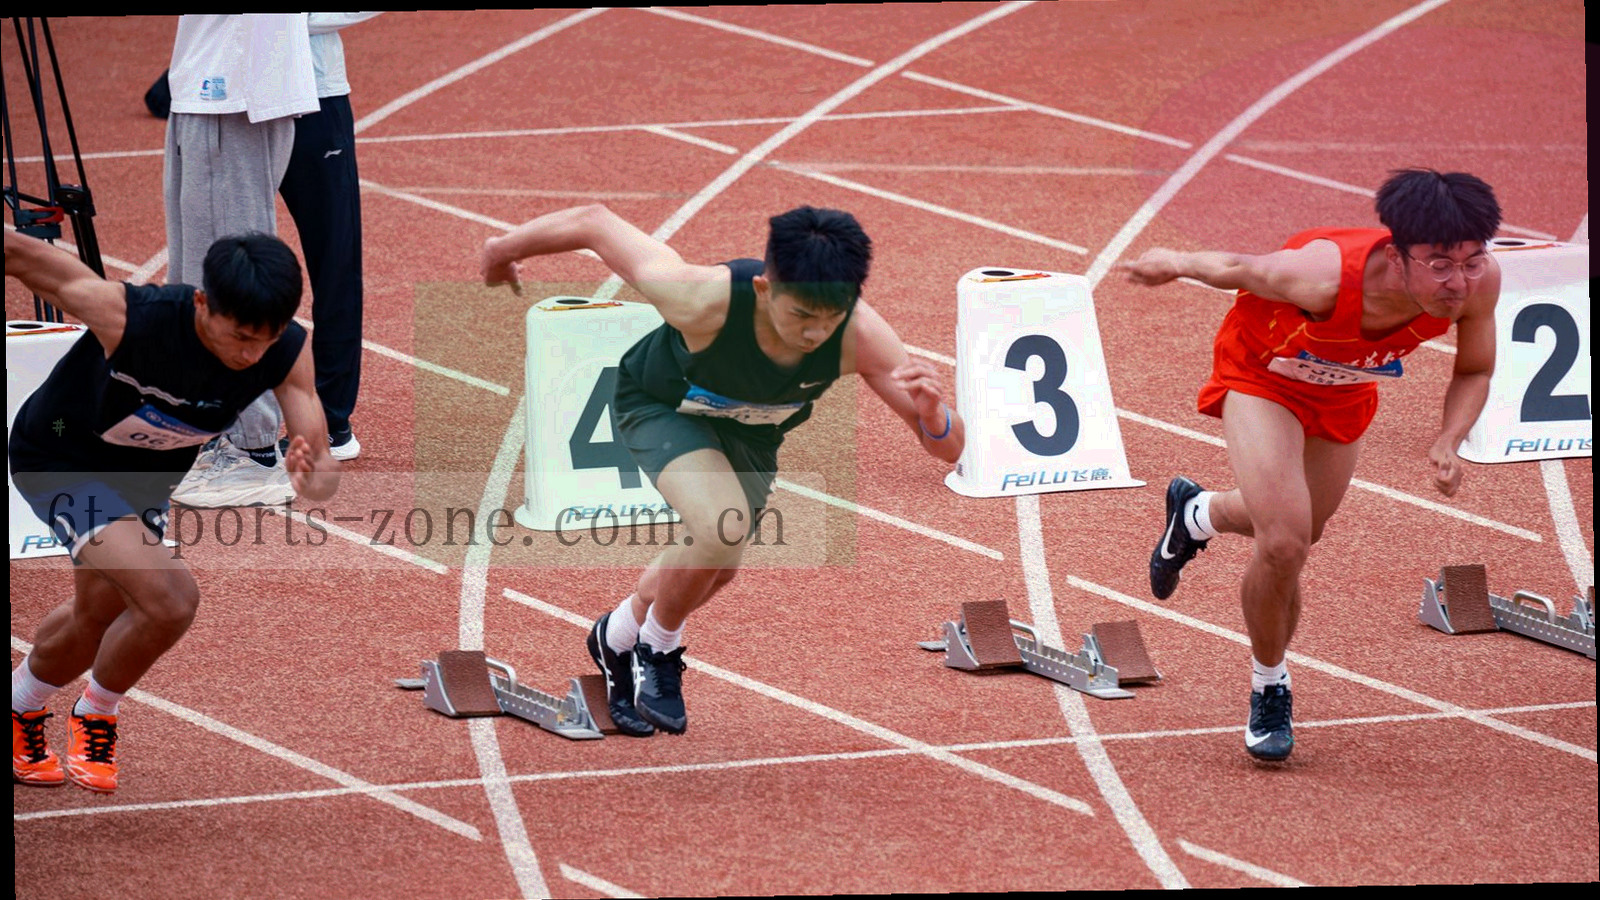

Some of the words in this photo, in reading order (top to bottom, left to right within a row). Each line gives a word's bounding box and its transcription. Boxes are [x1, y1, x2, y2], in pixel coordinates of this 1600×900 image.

[1004, 334, 1080, 456] 3
[1511, 303, 1592, 422] 2
[569, 366, 643, 489] 4
